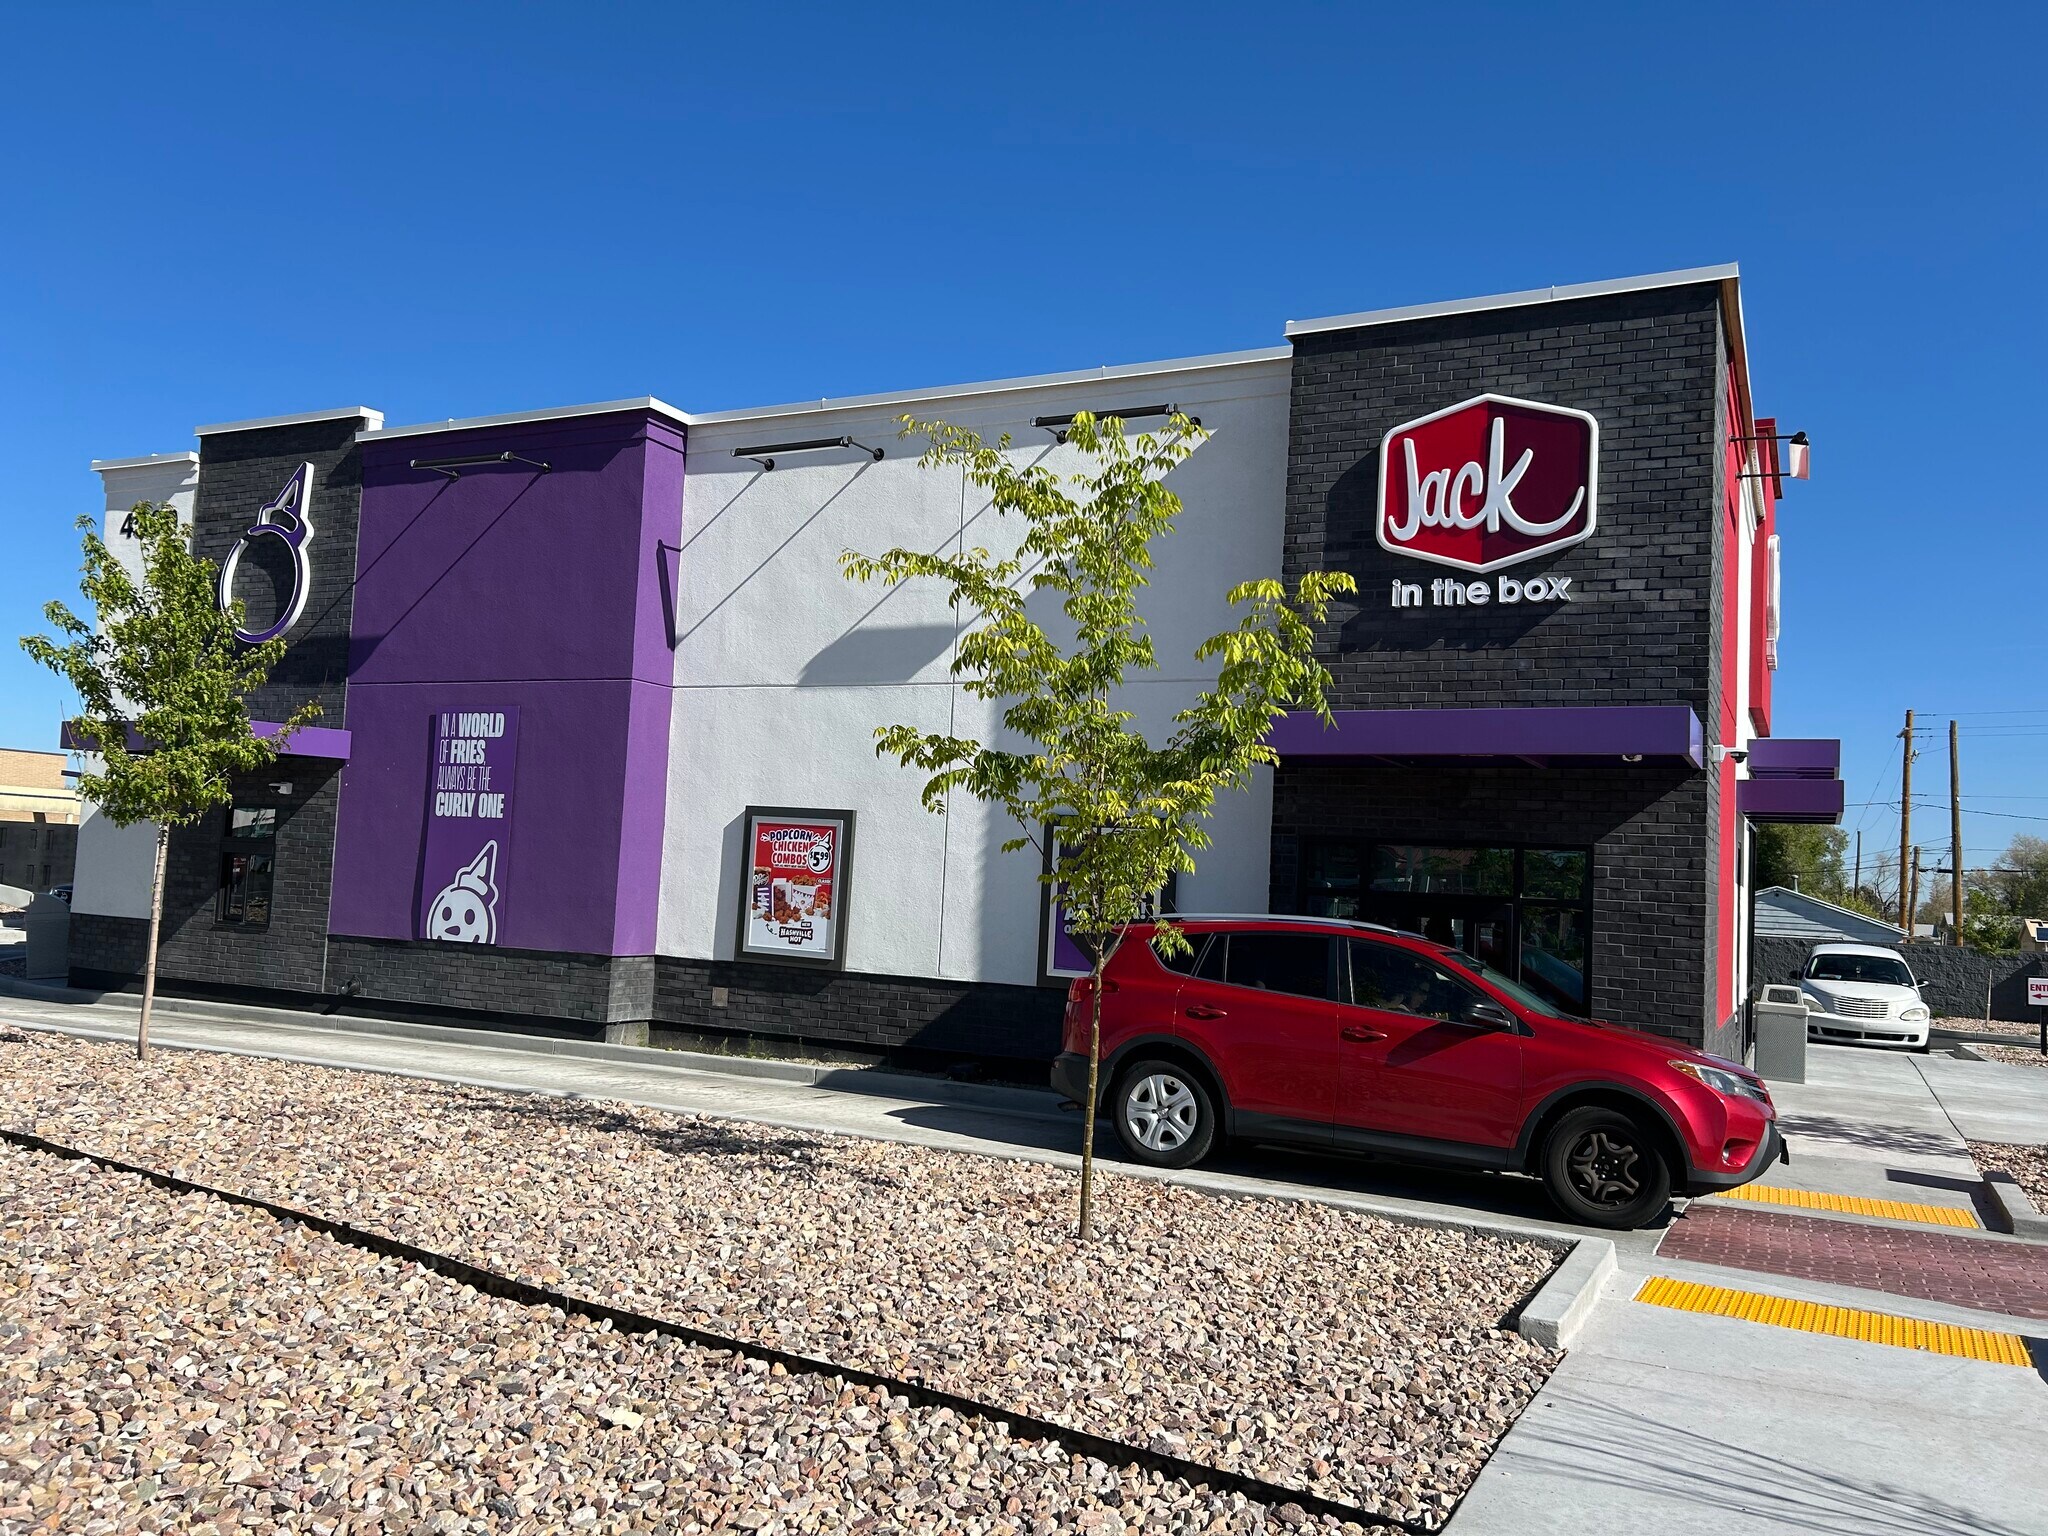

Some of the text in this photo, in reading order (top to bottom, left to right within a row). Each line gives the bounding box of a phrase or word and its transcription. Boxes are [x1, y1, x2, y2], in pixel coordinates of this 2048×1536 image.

[1388, 417, 1585, 541] Jack
[1391, 575, 1572, 608] in the box
[441, 713, 450, 737] IN
[458, 712, 505, 738] WORLD
[439, 739, 486, 766] OF FRIES,
[436, 765, 492, 791] ALWAYS BE THE
[435, 791, 505, 819] CURLY ONE
[769, 829, 812, 841] POPCORN
[773, 841, 809, 853] CHICKEN
[772, 853, 807, 865] COMBOS
